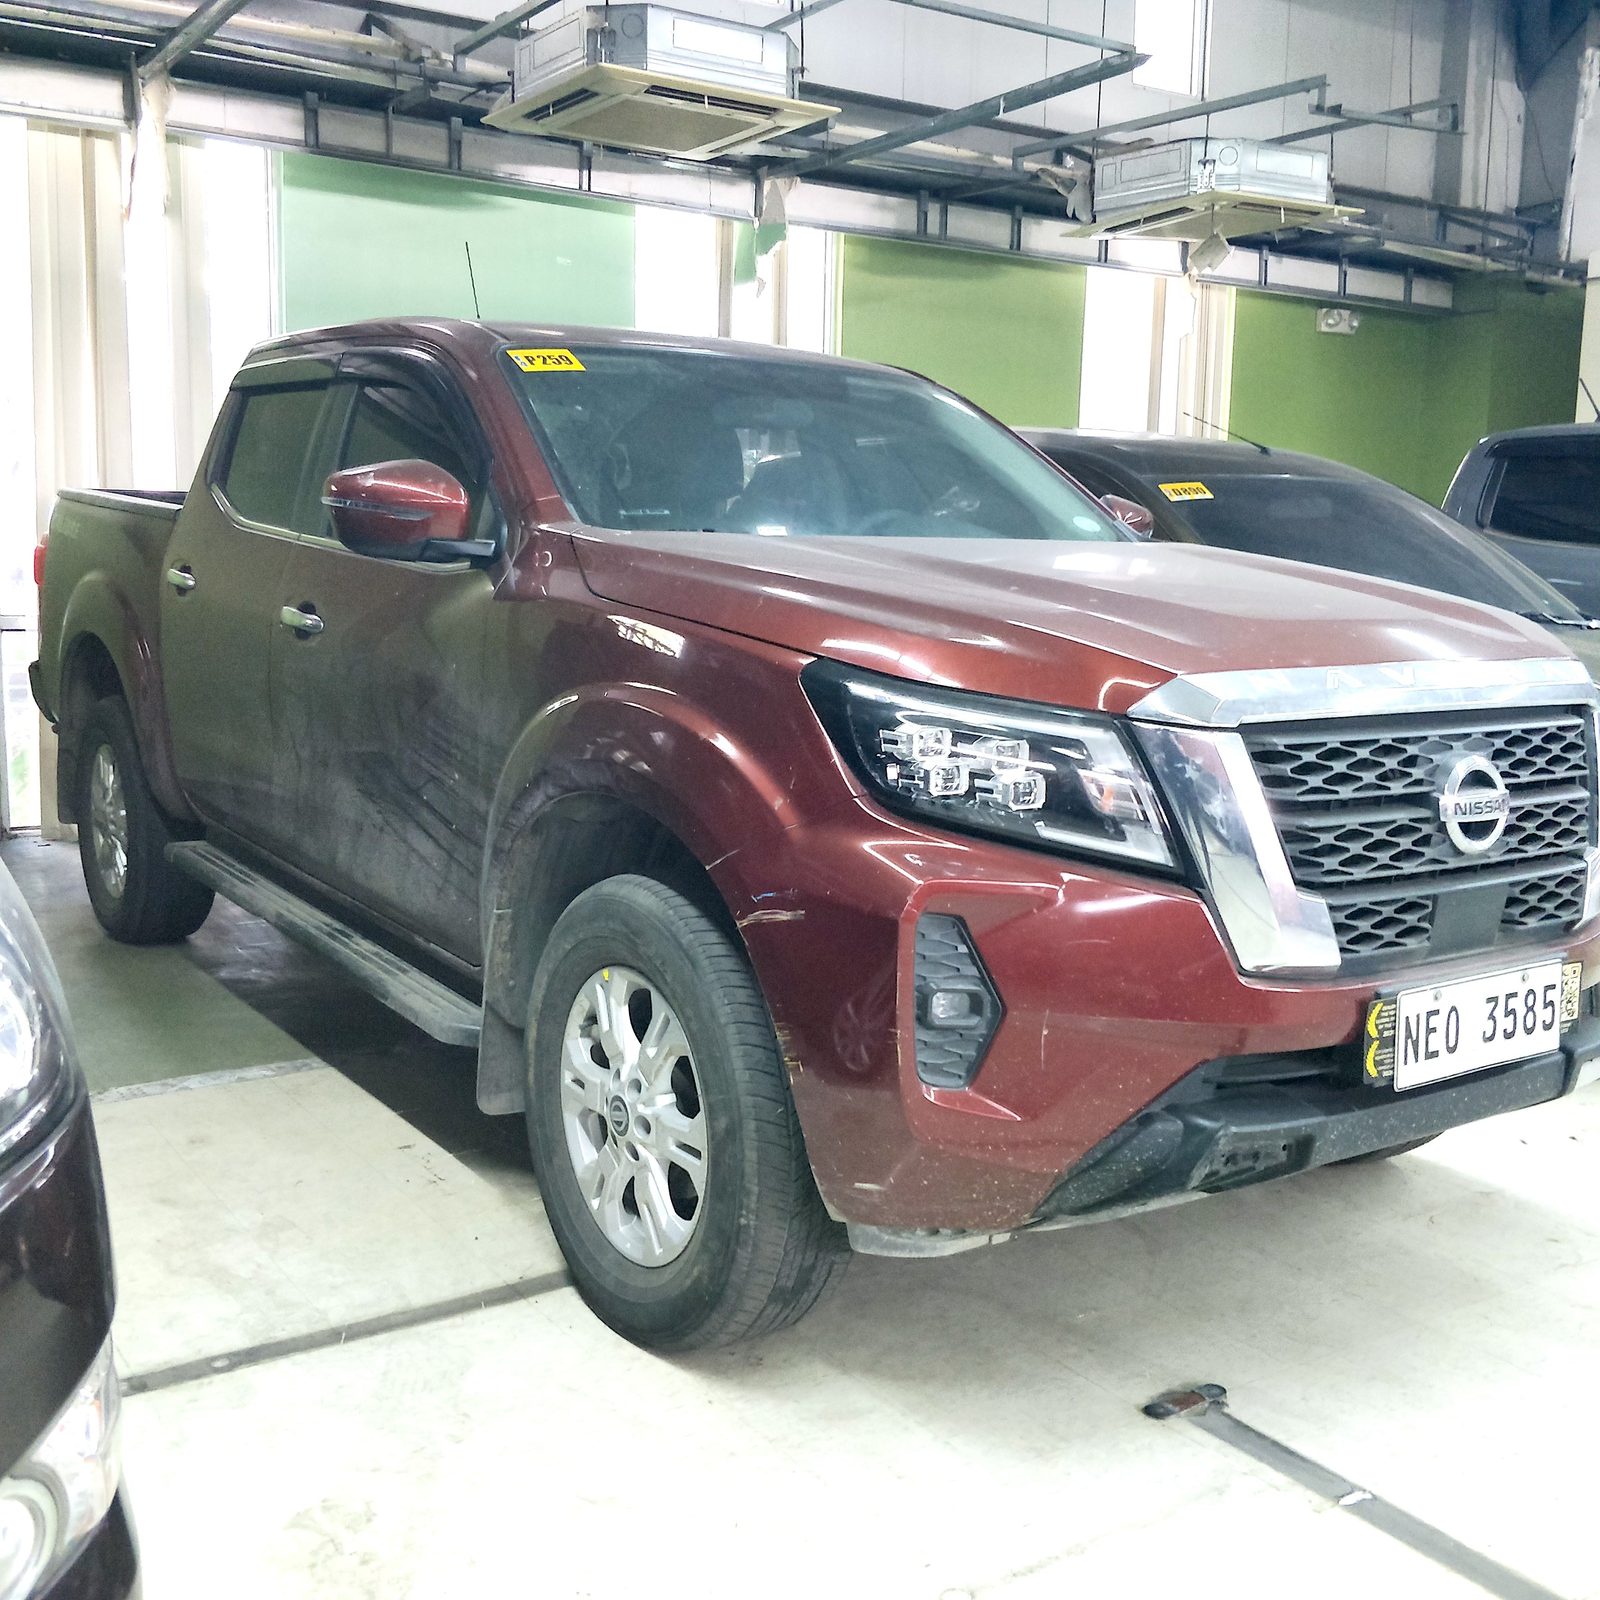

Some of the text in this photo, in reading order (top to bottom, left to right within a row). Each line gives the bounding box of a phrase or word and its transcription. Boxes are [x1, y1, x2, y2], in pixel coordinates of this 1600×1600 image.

[524, 354, 573, 366] P259
[1404, 1005, 1460, 1066] NEO
[1482, 984, 1556, 1043] 3585
